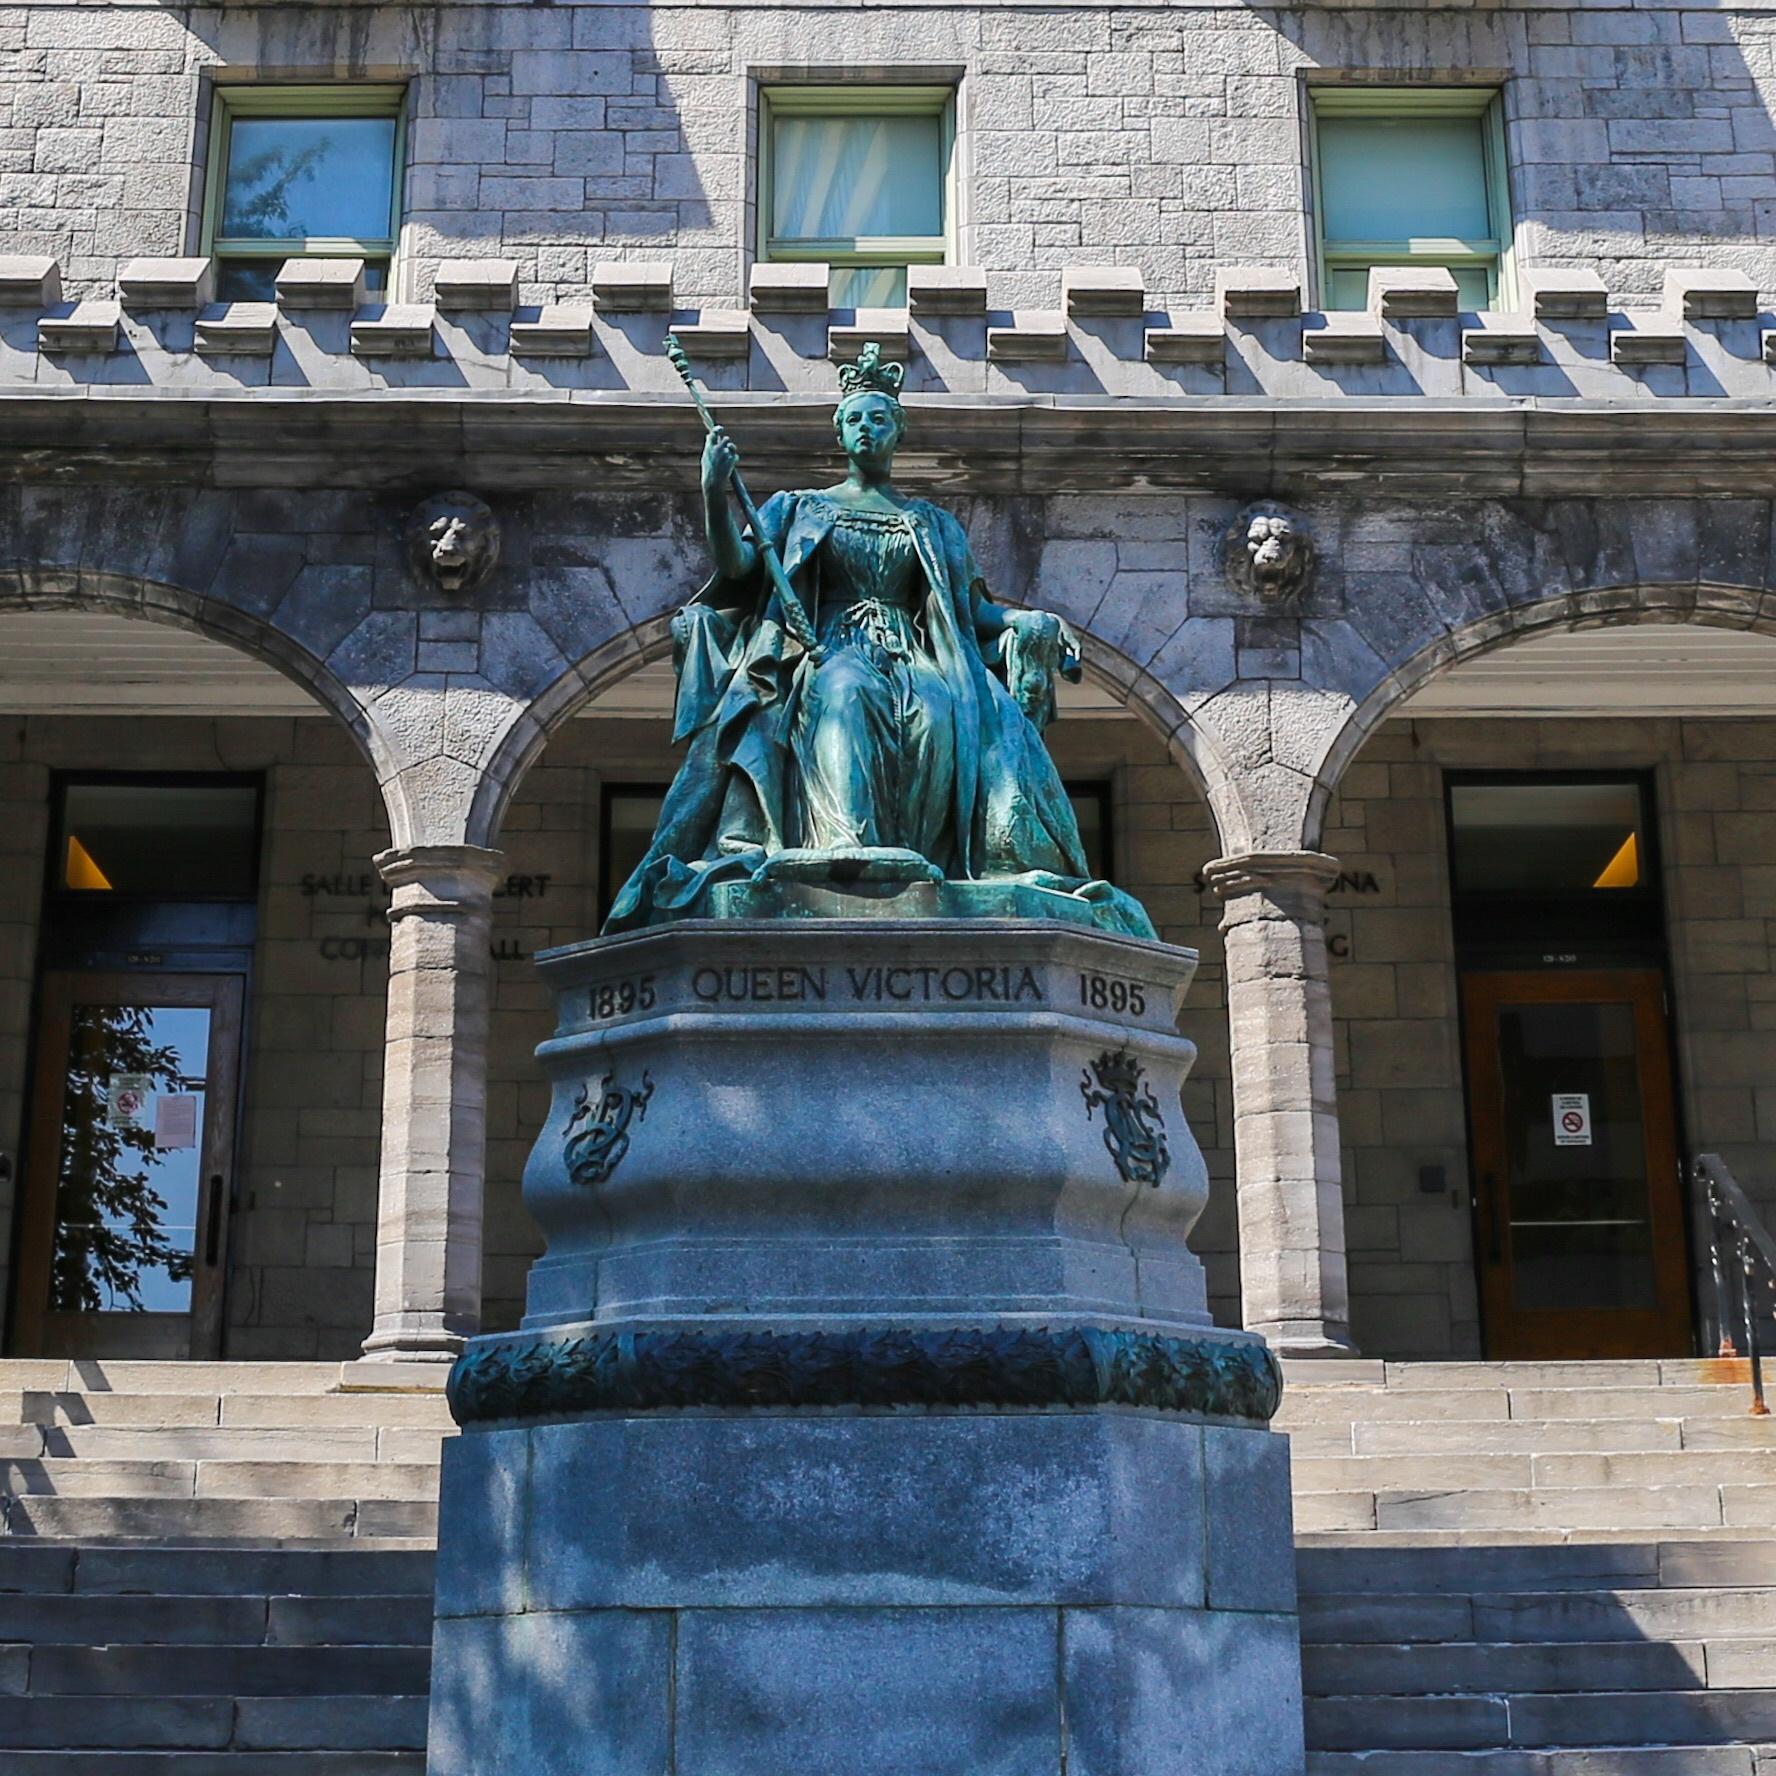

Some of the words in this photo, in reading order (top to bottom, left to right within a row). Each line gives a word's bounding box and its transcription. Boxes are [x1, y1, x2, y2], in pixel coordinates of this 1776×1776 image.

[588, 976, 656, 1021] 1895
[692, 966, 827, 1002] QUEEN
[846, 966, 1044, 1002] VICTORIA
[1079, 973, 1146, 1017] 1895
